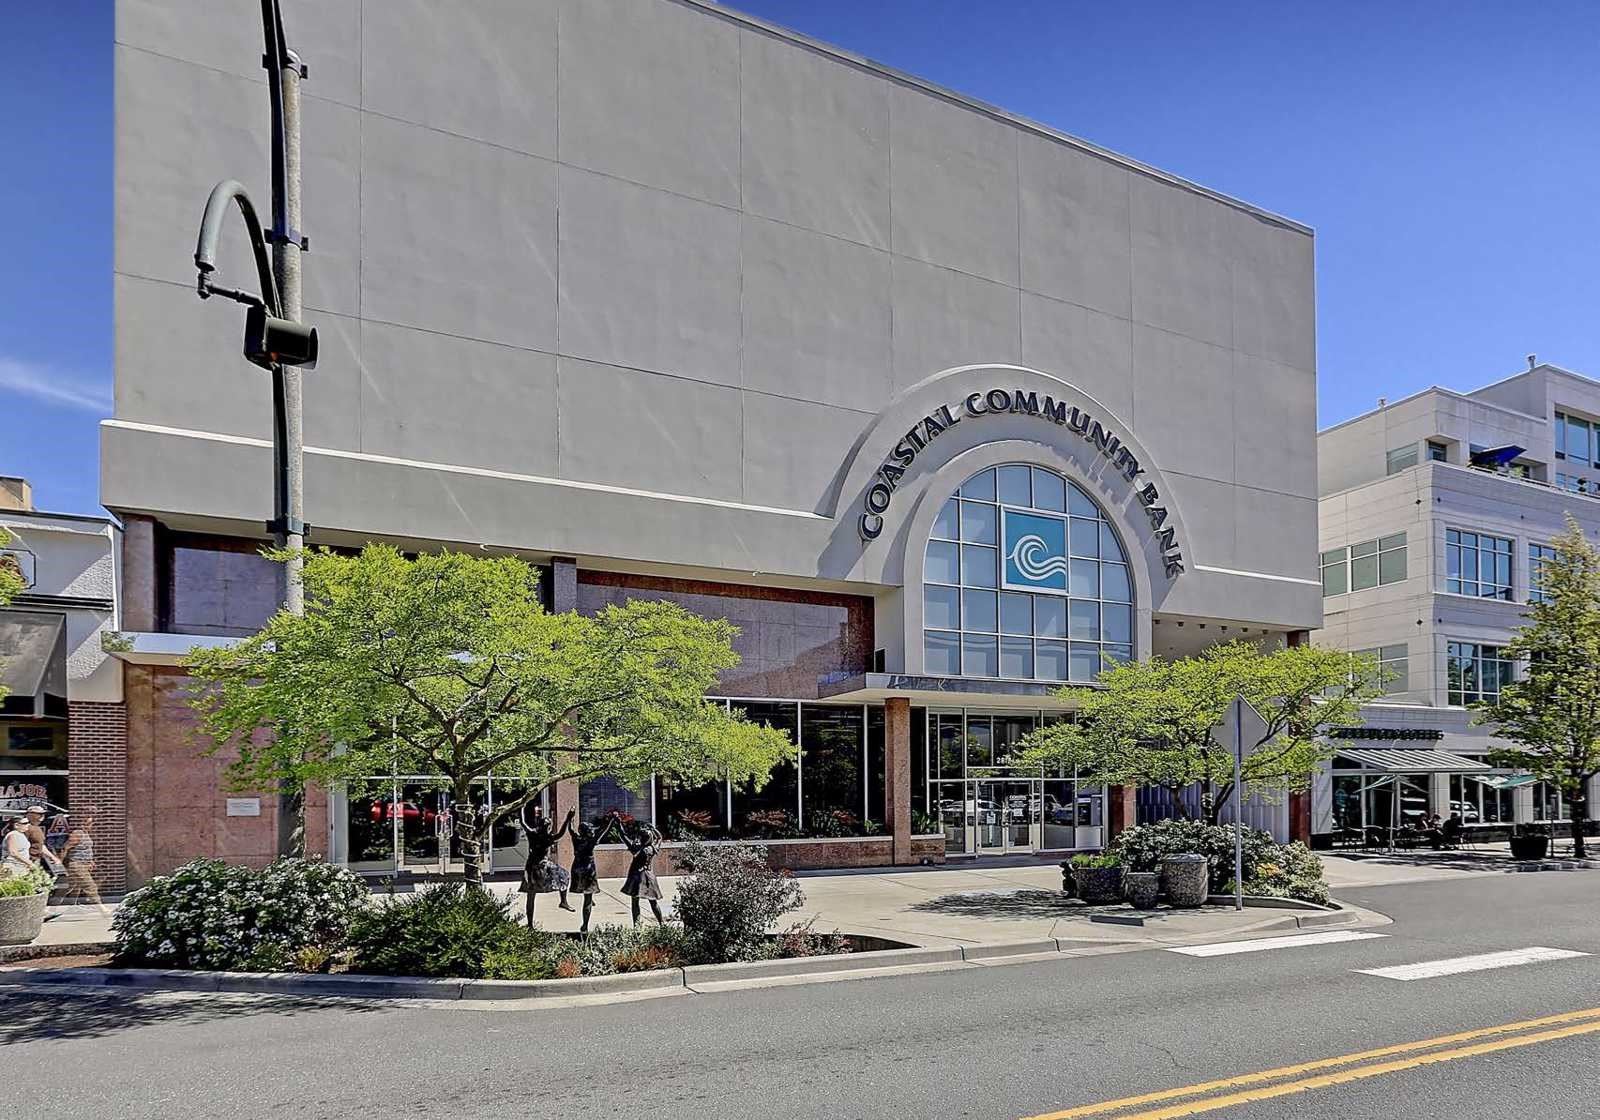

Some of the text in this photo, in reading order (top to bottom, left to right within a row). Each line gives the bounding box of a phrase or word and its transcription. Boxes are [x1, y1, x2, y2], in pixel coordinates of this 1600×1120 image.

[859, 389, 1186, 579] COASTAL COMMUNITY BANK
